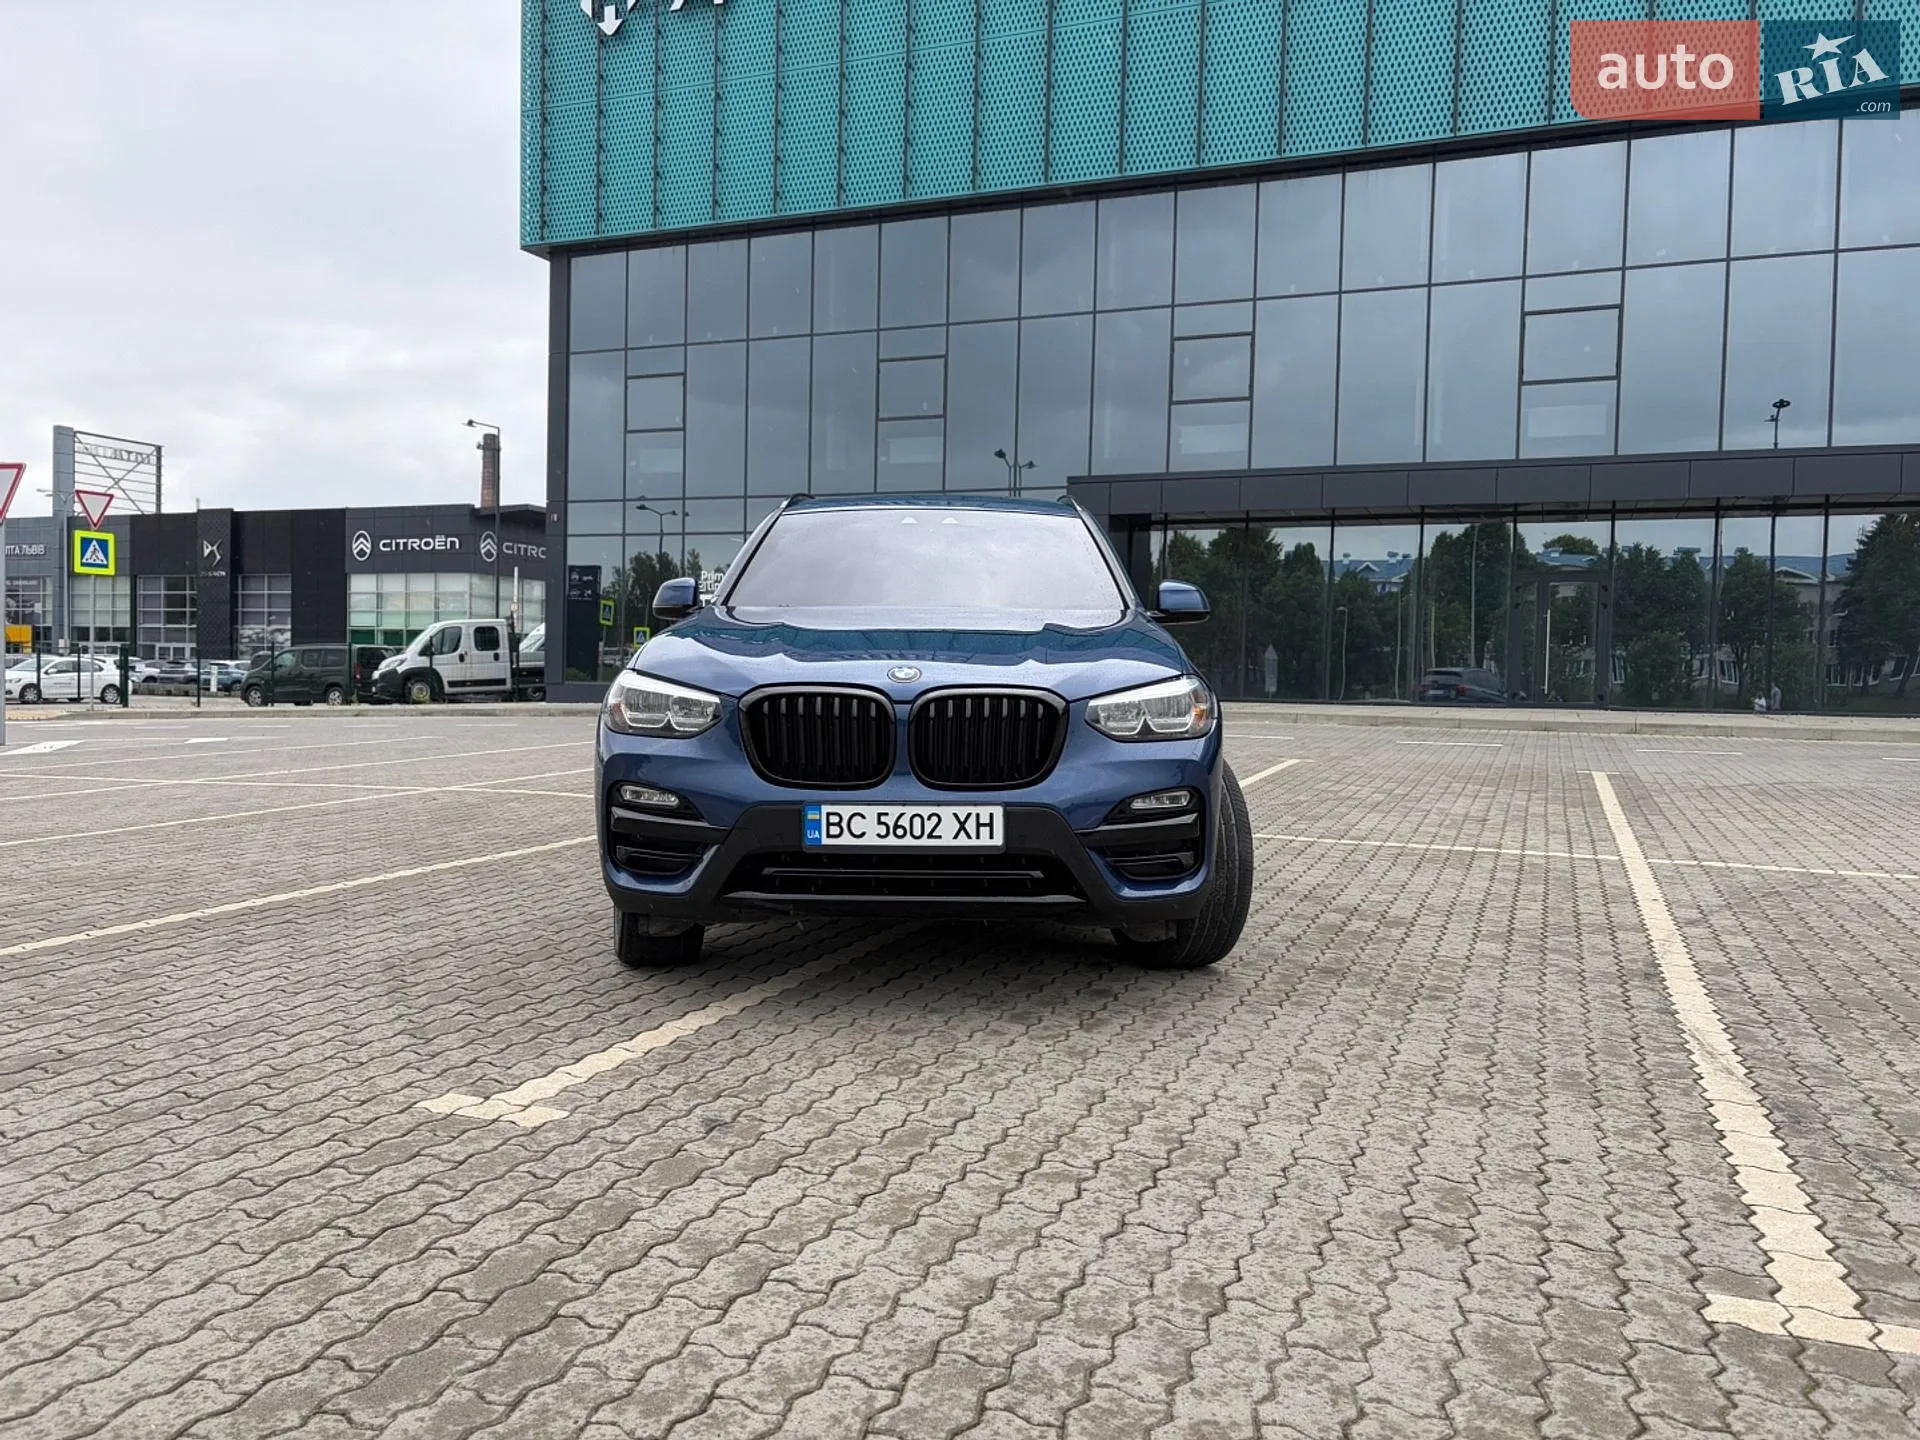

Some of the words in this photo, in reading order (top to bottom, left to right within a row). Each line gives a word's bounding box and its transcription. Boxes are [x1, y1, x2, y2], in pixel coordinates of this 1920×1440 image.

[807, 830, 820, 839] UA
[826, 812, 867, 839] BC
[876, 812, 942, 840] 5602
[952, 812, 995, 840] XH
